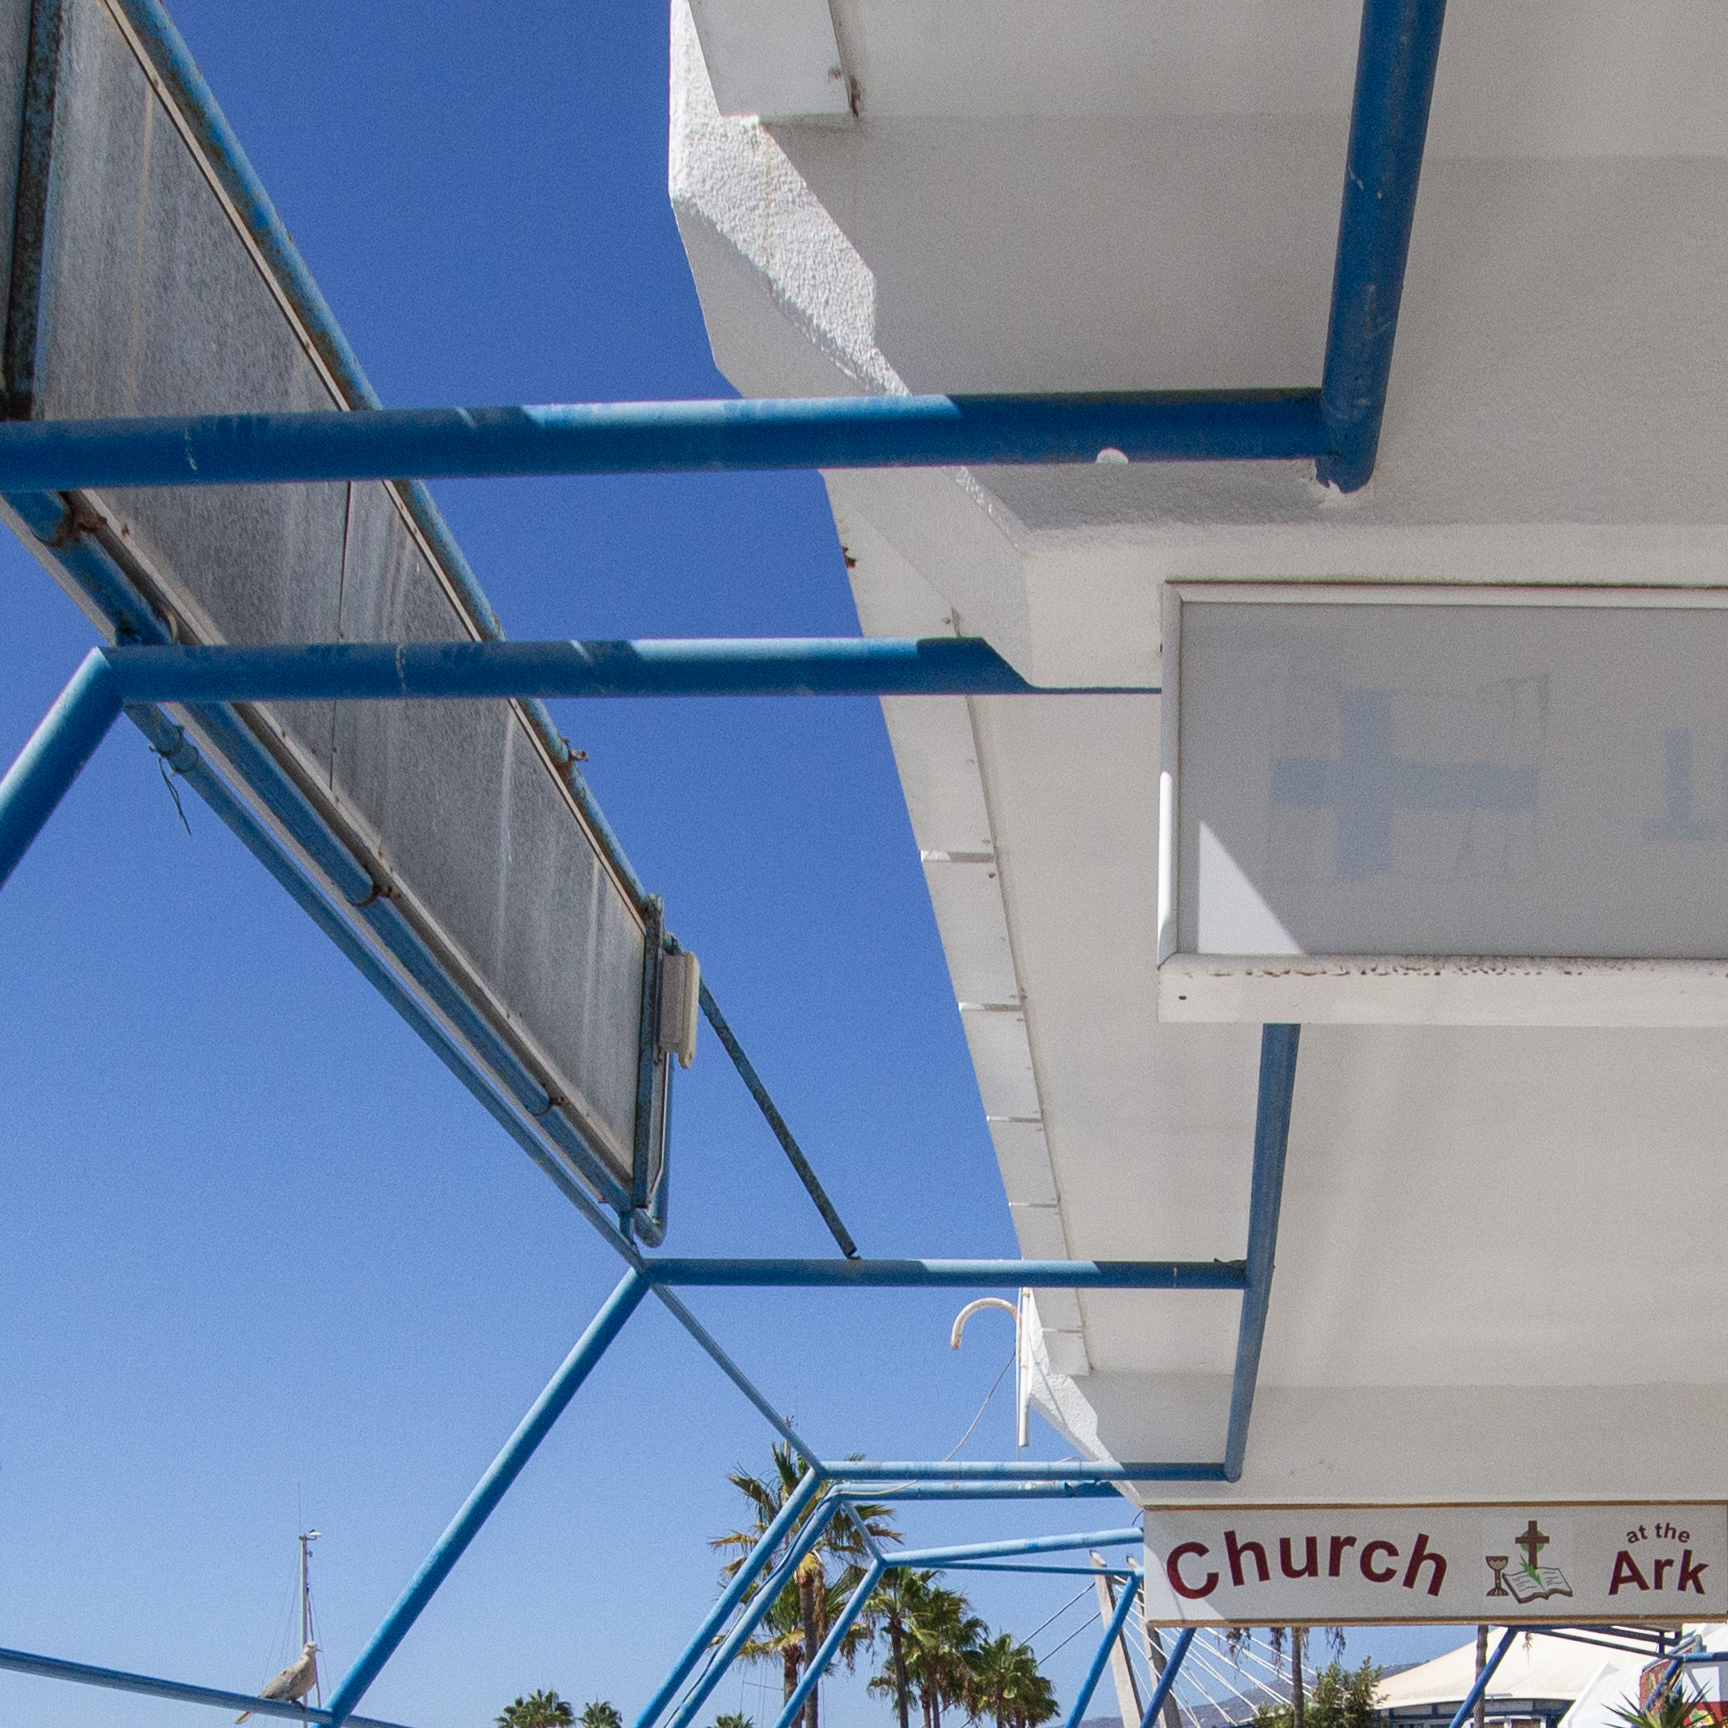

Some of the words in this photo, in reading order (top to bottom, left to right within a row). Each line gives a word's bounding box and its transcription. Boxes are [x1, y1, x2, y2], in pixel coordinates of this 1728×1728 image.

[1625, 1523, 1649, 1545] at
[1652, 1521, 1692, 1544] the
[1166, 1529, 1448, 1599] Church
[1607, 1548, 1710, 1596] Ark
